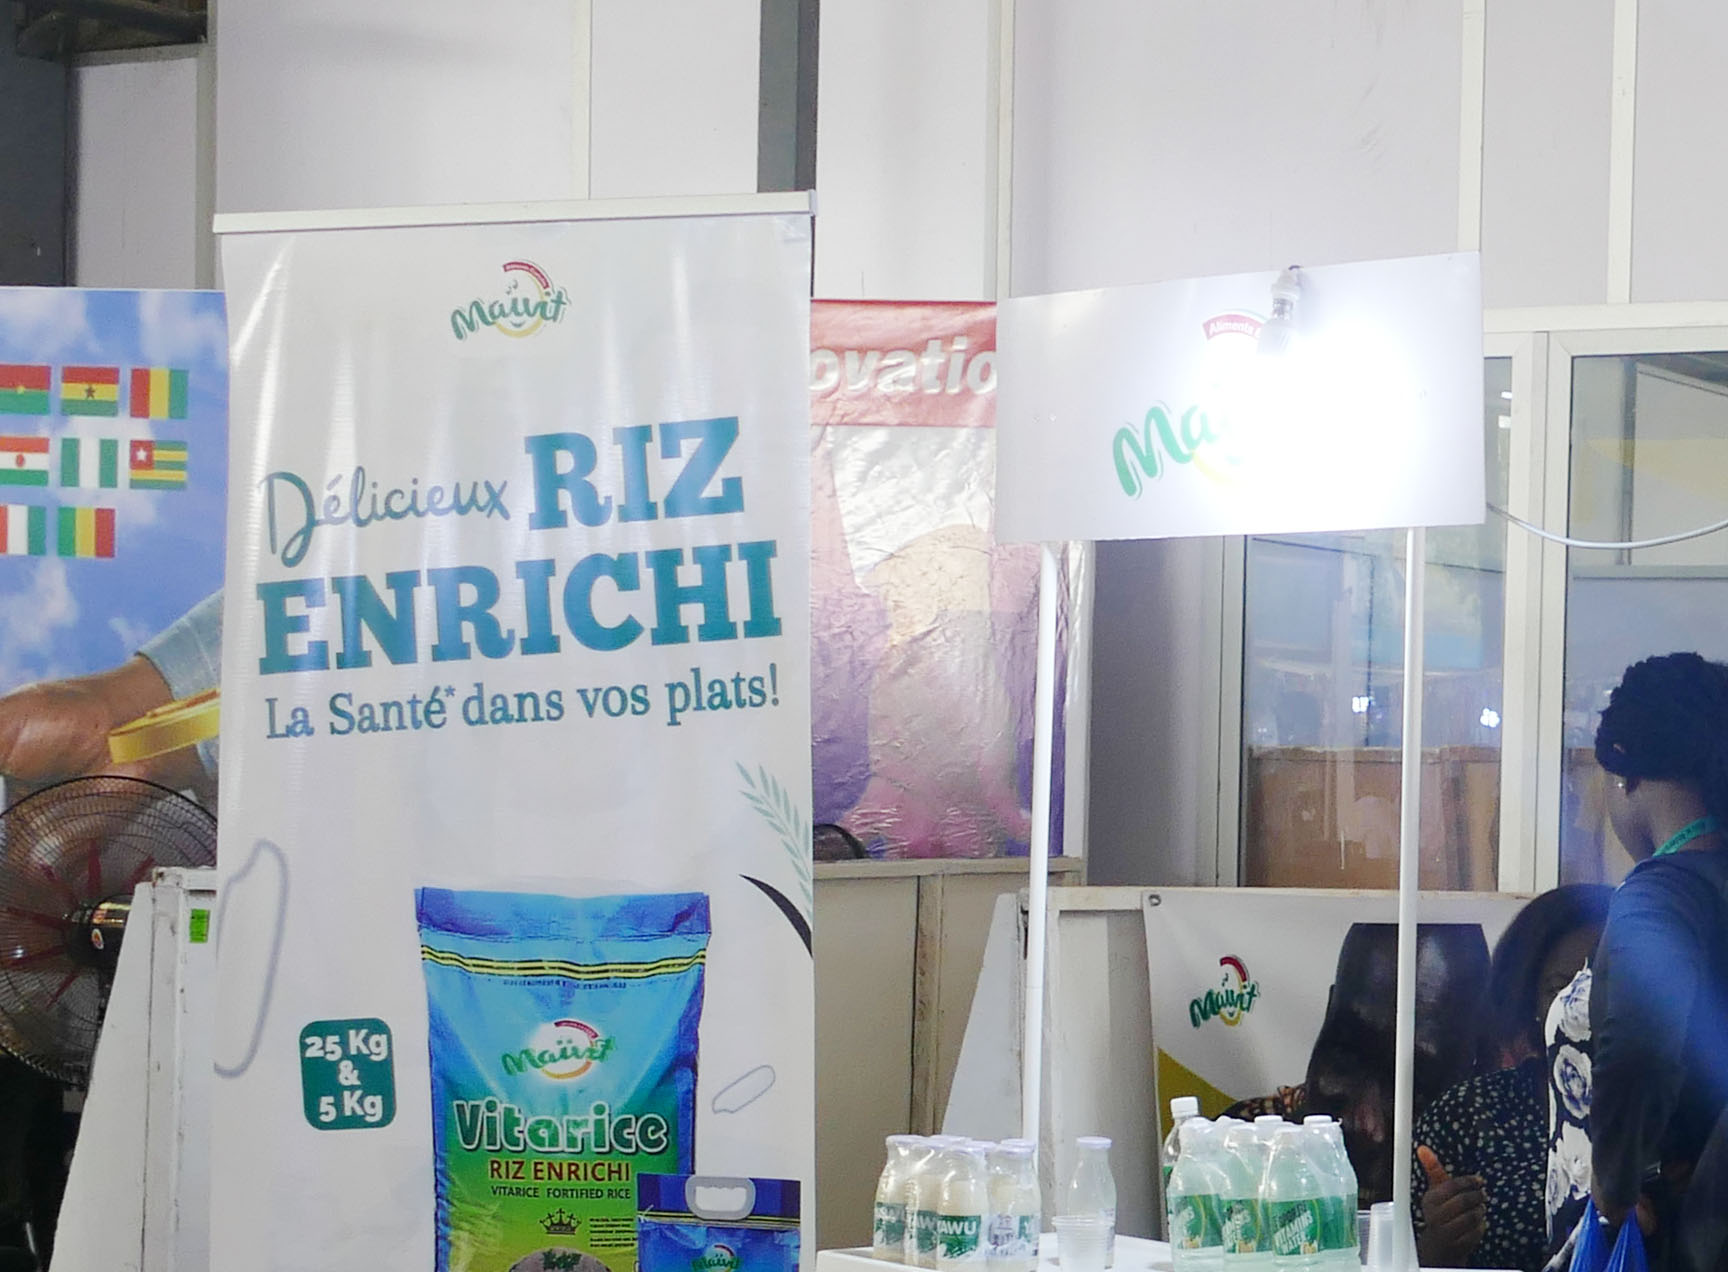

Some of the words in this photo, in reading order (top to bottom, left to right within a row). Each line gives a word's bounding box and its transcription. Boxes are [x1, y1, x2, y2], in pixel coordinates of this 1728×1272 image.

[810, 336, 996, 396] ovatio
[258, 466, 512, 568] Délicieux
[523, 416, 746, 531] RIZ
[257, 540, 783, 675] ENRICHI
[266, 696, 314, 740] La
[462, 684, 563, 729] dans
[578, 684, 651, 720] vos
[665, 663, 781, 727] plats!
[304, 1034, 342, 1061] 25
[347, 1028, 388, 1060] Kg
[337, 1059, 360, 1087] &
[318, 1097, 336, 1123] 5
[343, 1092, 383, 1121] Kg
[453, 1096, 668, 1154] Vitarice
[489, 1159, 526, 1181] RIZ
[533, 1160, 631, 1182] ENRICHI
[491, 1185, 540, 1198] VITARICE
[546, 1186, 604, 1199] FORTIFIED
[607, 1188, 631, 1199] RICE
